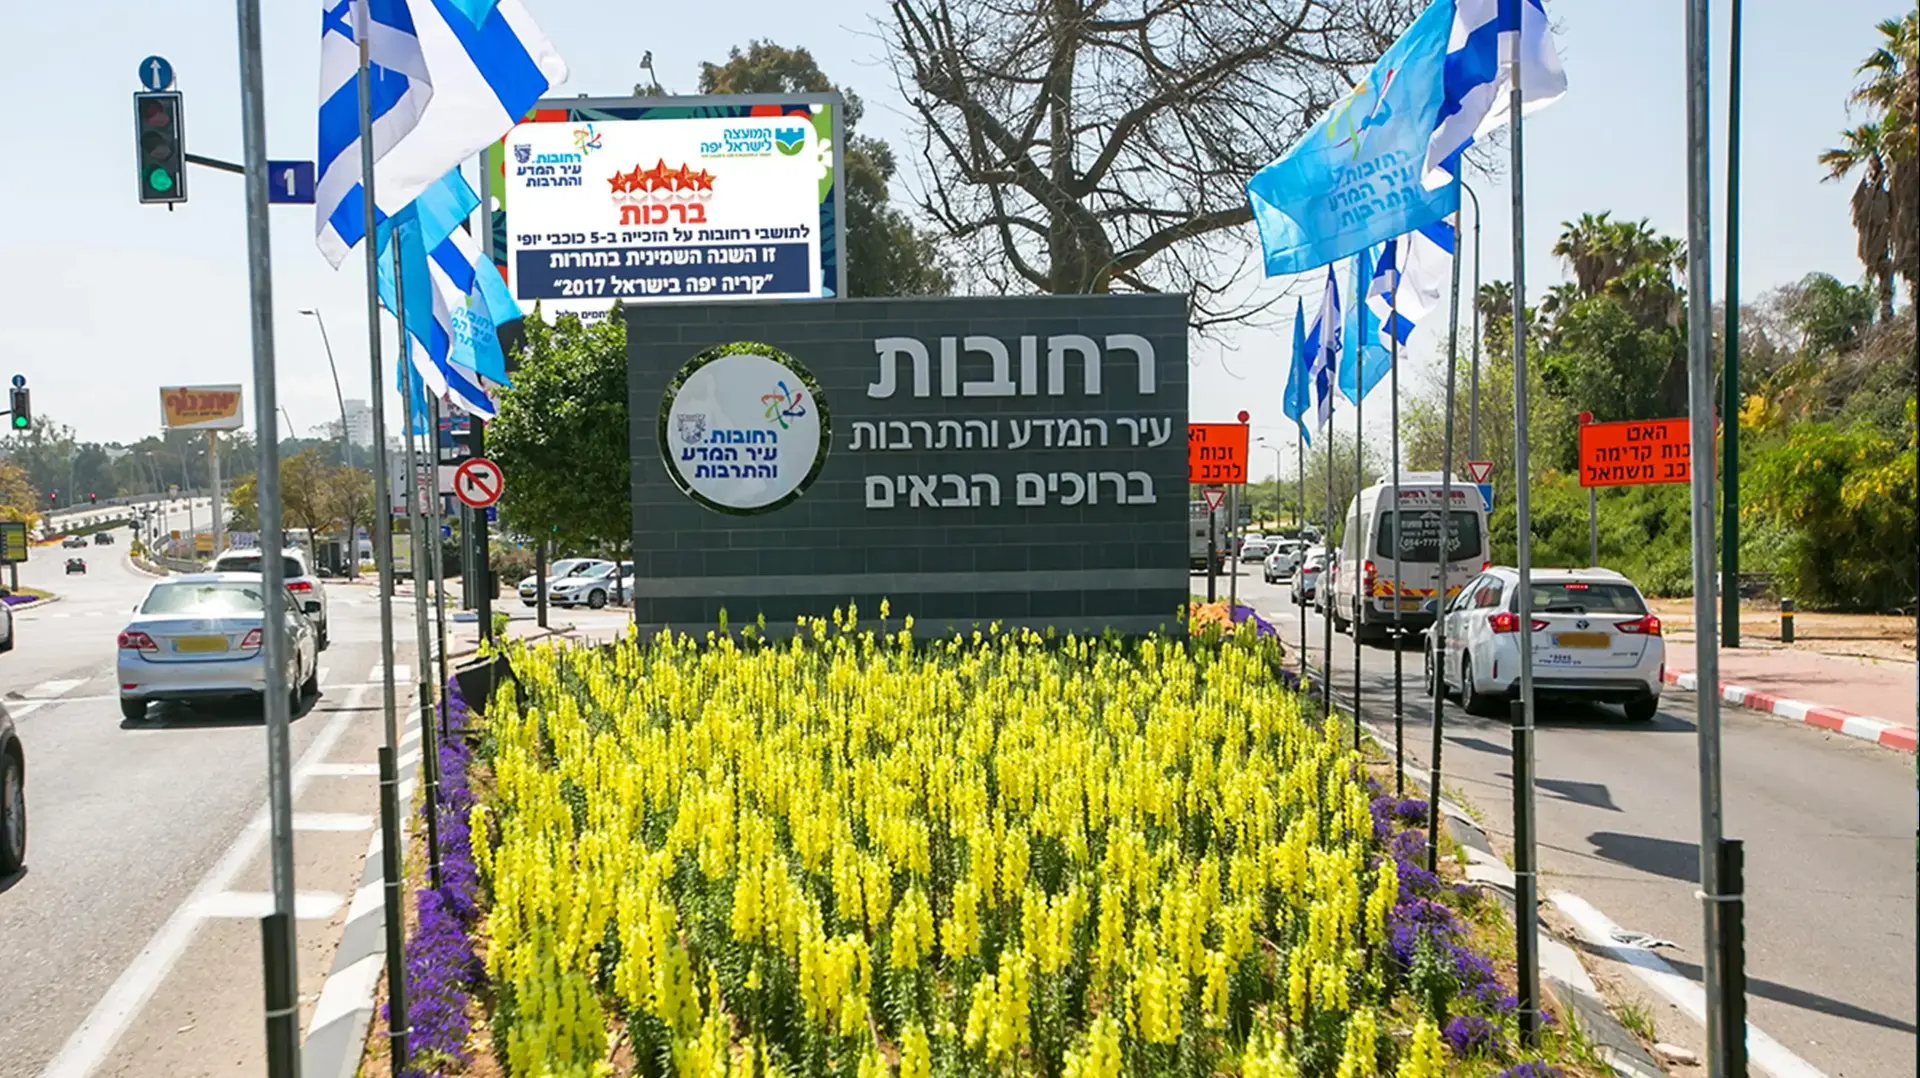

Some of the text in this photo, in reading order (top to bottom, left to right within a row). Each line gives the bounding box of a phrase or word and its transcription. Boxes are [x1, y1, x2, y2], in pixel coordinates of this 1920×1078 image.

[723, 128, 772, 140] המועצה
[700, 138, 772, 153] לישראל יפה
[516, 164, 582, 176] עיר המדע
[283, 168, 296, 196] 1
[526, 176, 582, 188] והתרבות
[1327, 164, 1415, 213] עיר המדע
[619, 202, 707, 226] ברכות
[516, 224, 810, 246] לתושבי רחובות על הזכייה ב-5 כוכבי יופי
[549, 247, 777, 269] זו השנה השמינית בתחרות
[611, 275, 682, 294] בישראל
[686, 276, 717, 293] יפה
[581, 310, 609, 319] חמים
[868, 334, 1156, 398] רחובות
[849, 417, 1171, 450] עיר המדע והתרבות
[1626, 425, 1668, 442] האט
[681, 447, 778, 461] עיר המדע
[1200, 446, 1234, 461] זכות
[1595, 442, 1691, 463] כות קדימה
[694, 464, 778, 479] והתרבות
[1201, 462, 1242, 479] לרכב
[1586, 463, 1655, 481] משמאל
[865, 471, 1157, 508] ברוכים הבאים
